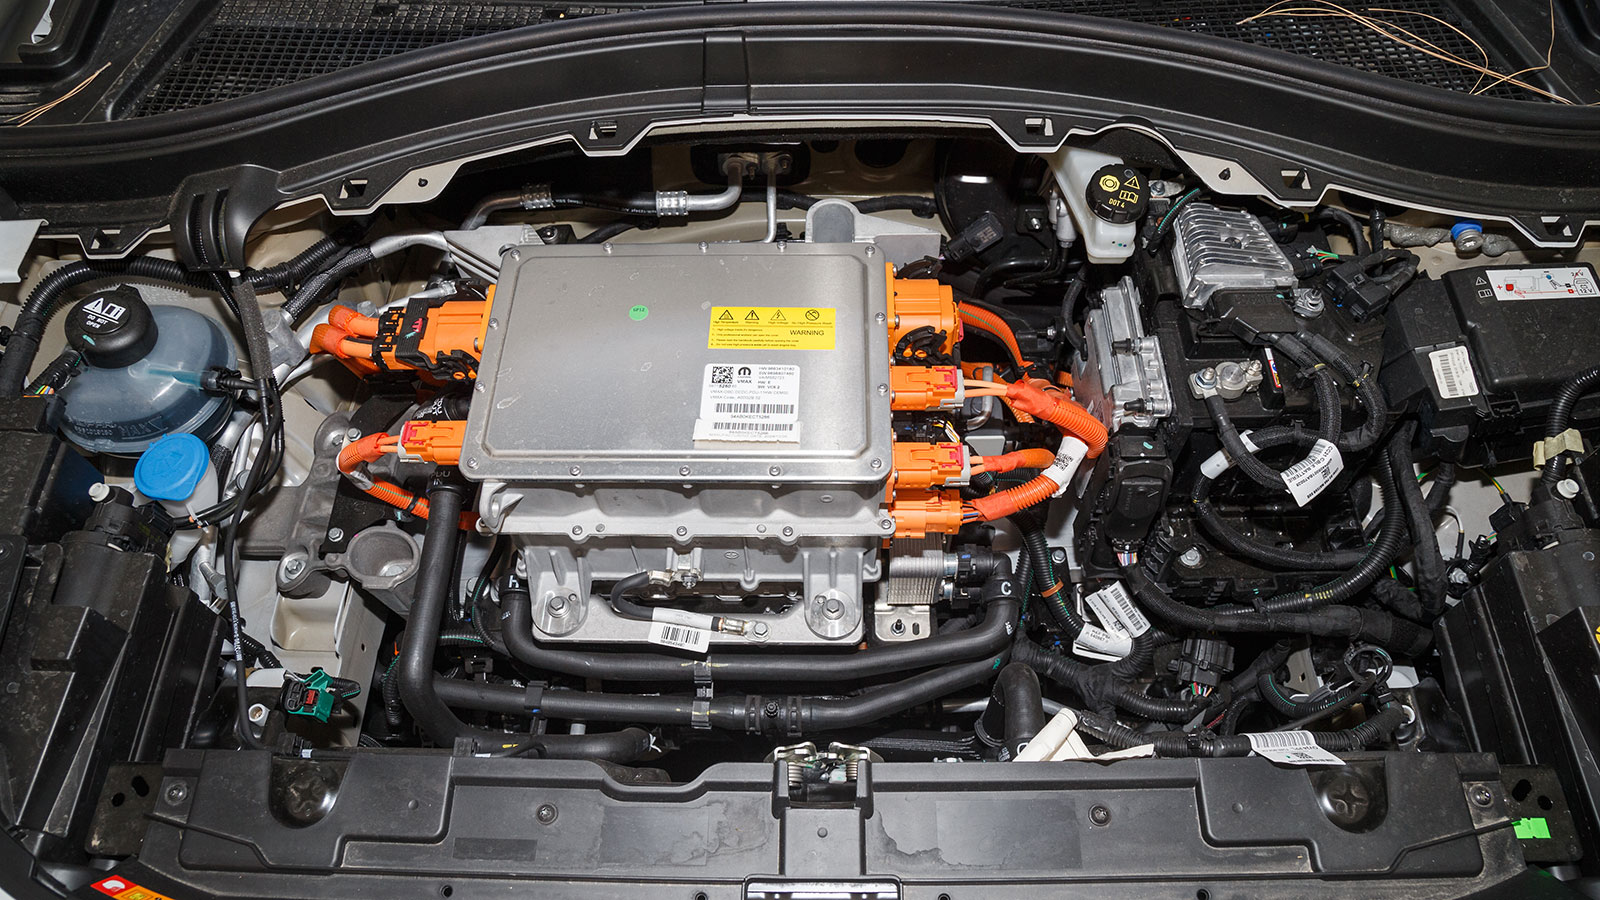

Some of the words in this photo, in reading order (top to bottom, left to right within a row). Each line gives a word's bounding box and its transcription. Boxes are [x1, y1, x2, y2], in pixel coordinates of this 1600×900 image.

[1109, 198, 1120, 207] DOT
[86, 320, 101, 329] OPEN
[96, 317, 109, 325] NOT
[1000, 581, 1012, 596] C
